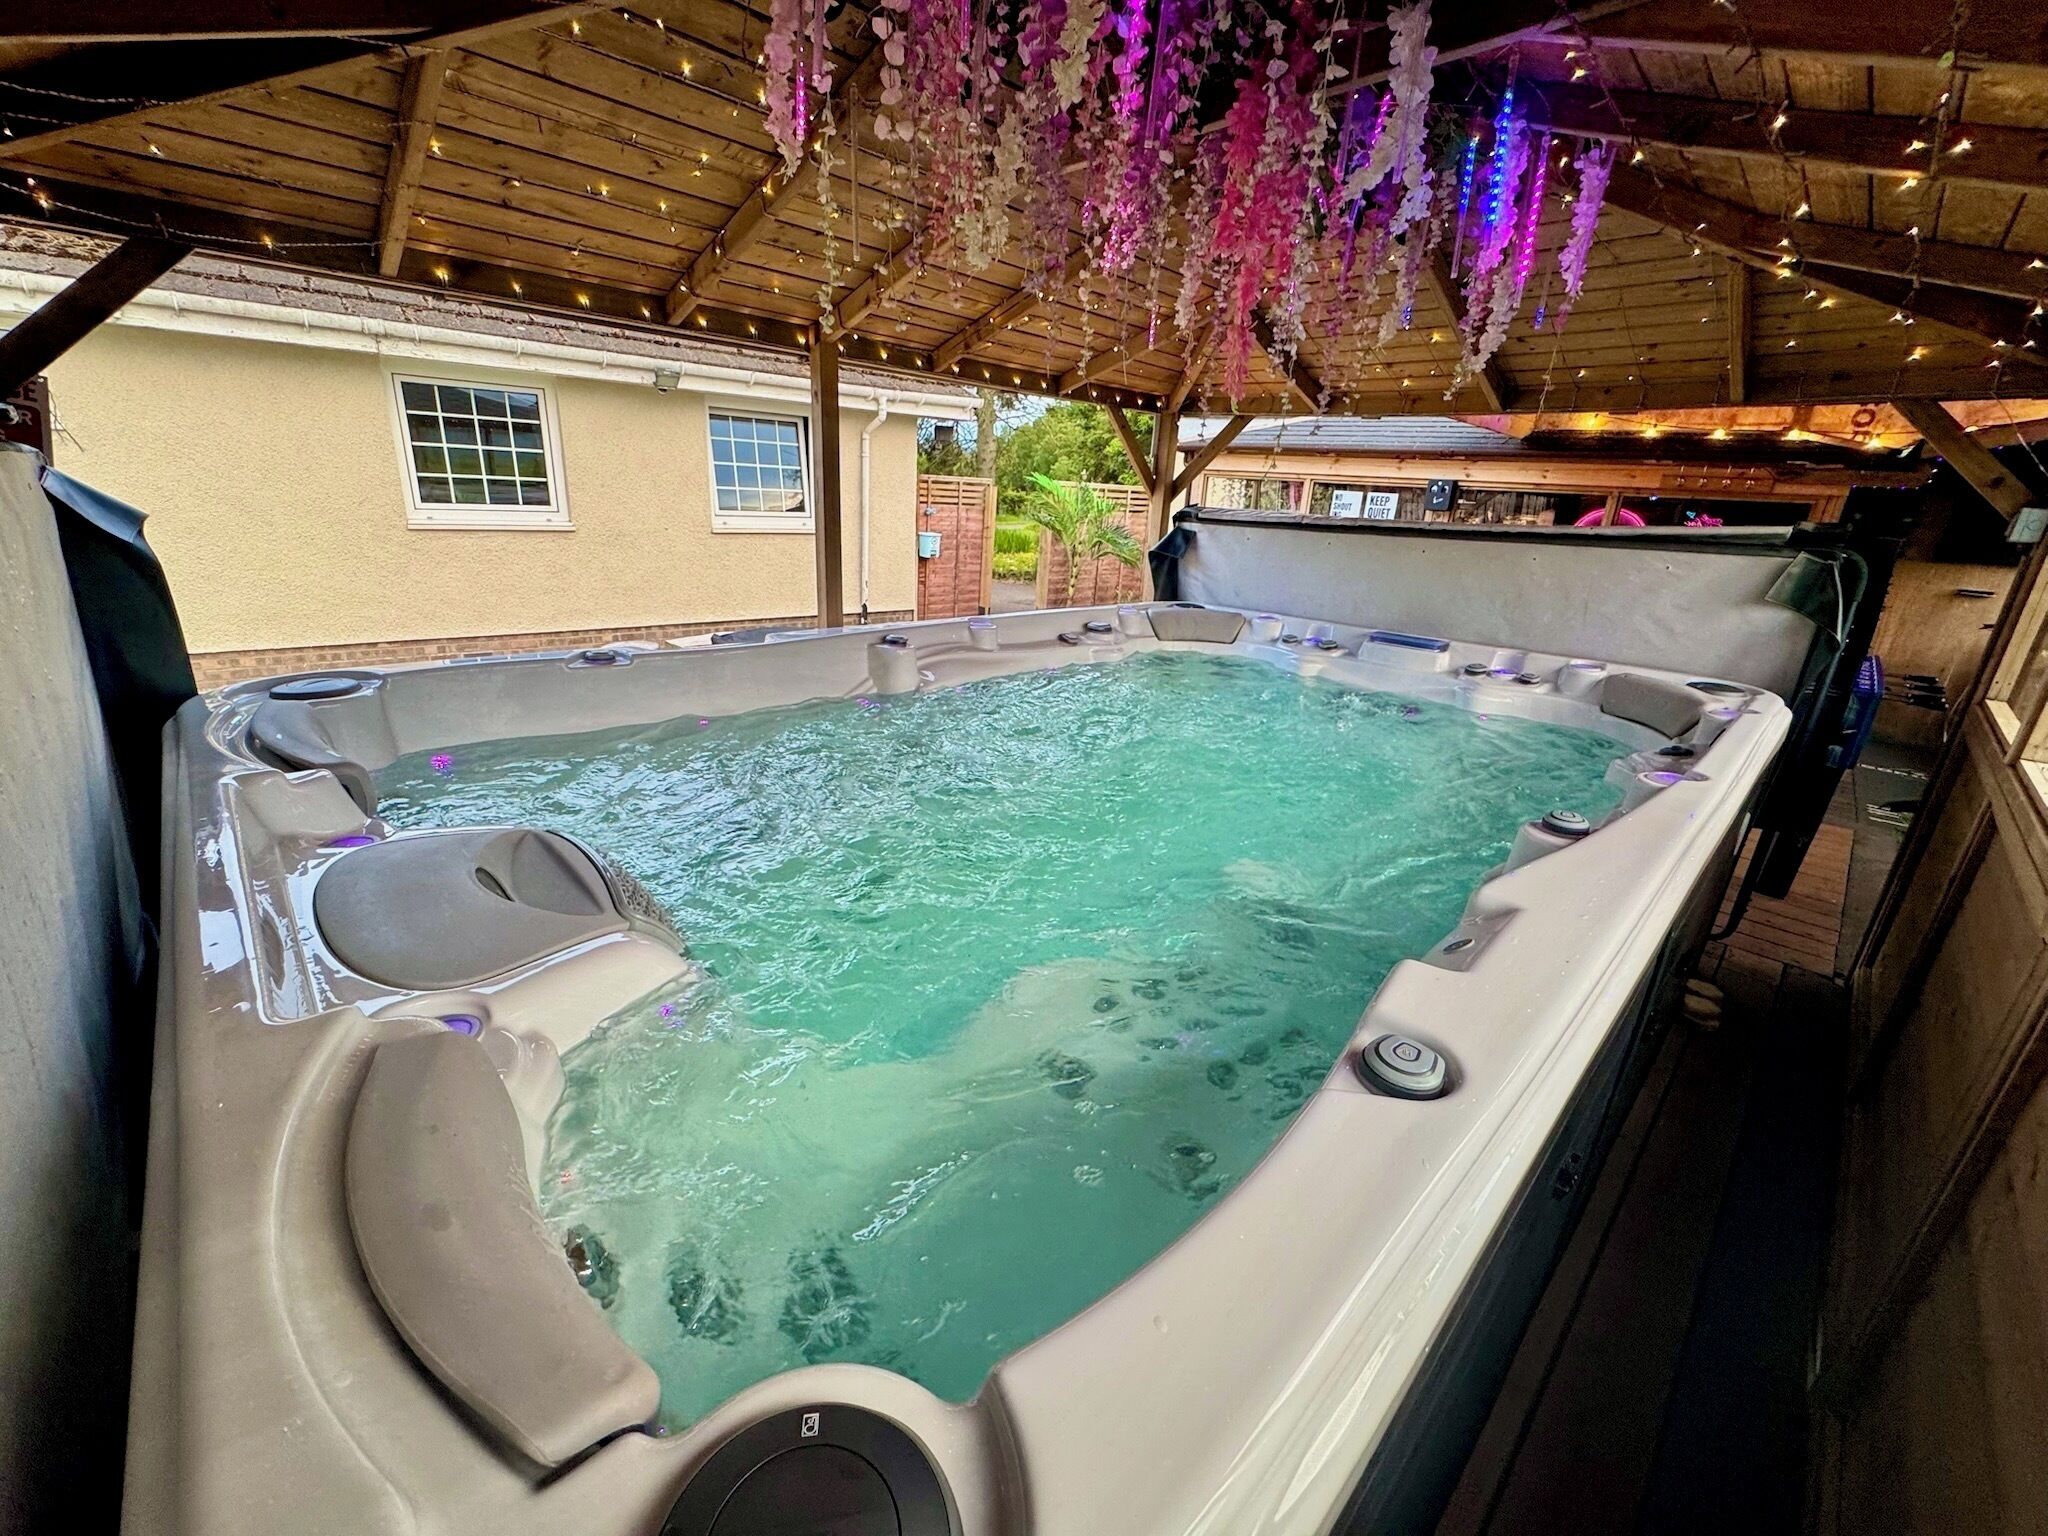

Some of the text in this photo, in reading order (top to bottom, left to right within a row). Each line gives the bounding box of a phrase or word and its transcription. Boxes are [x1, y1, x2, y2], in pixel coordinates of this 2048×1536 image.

[1369, 495, 1391, 506] KEEP
[1333, 502, 1352, 511] SHOUT
[1367, 507, 1391, 518] QUIET
